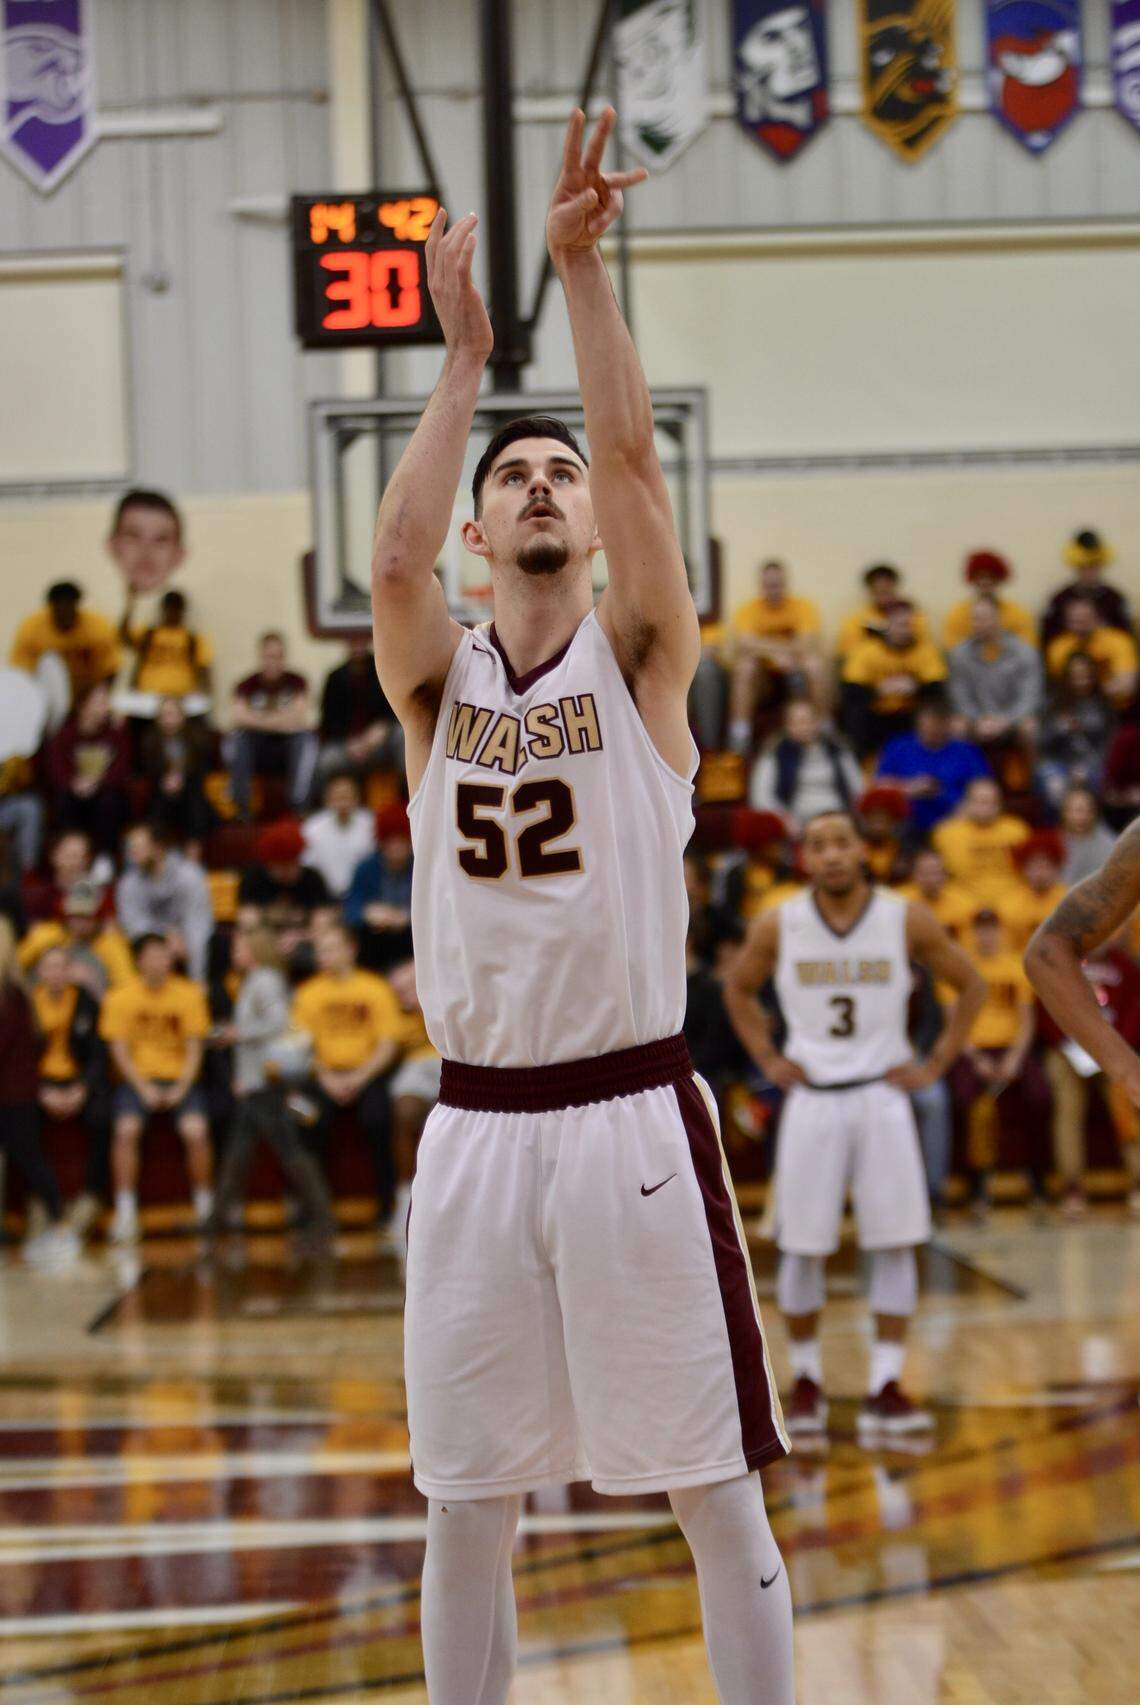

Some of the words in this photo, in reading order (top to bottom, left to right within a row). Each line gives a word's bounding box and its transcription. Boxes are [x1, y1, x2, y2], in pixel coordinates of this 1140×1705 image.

[320, 250, 421, 330] 30
[446, 693, 603, 776] WASH
[456, 776, 585, 881] 52
[829, 996, 856, 1038] 3
